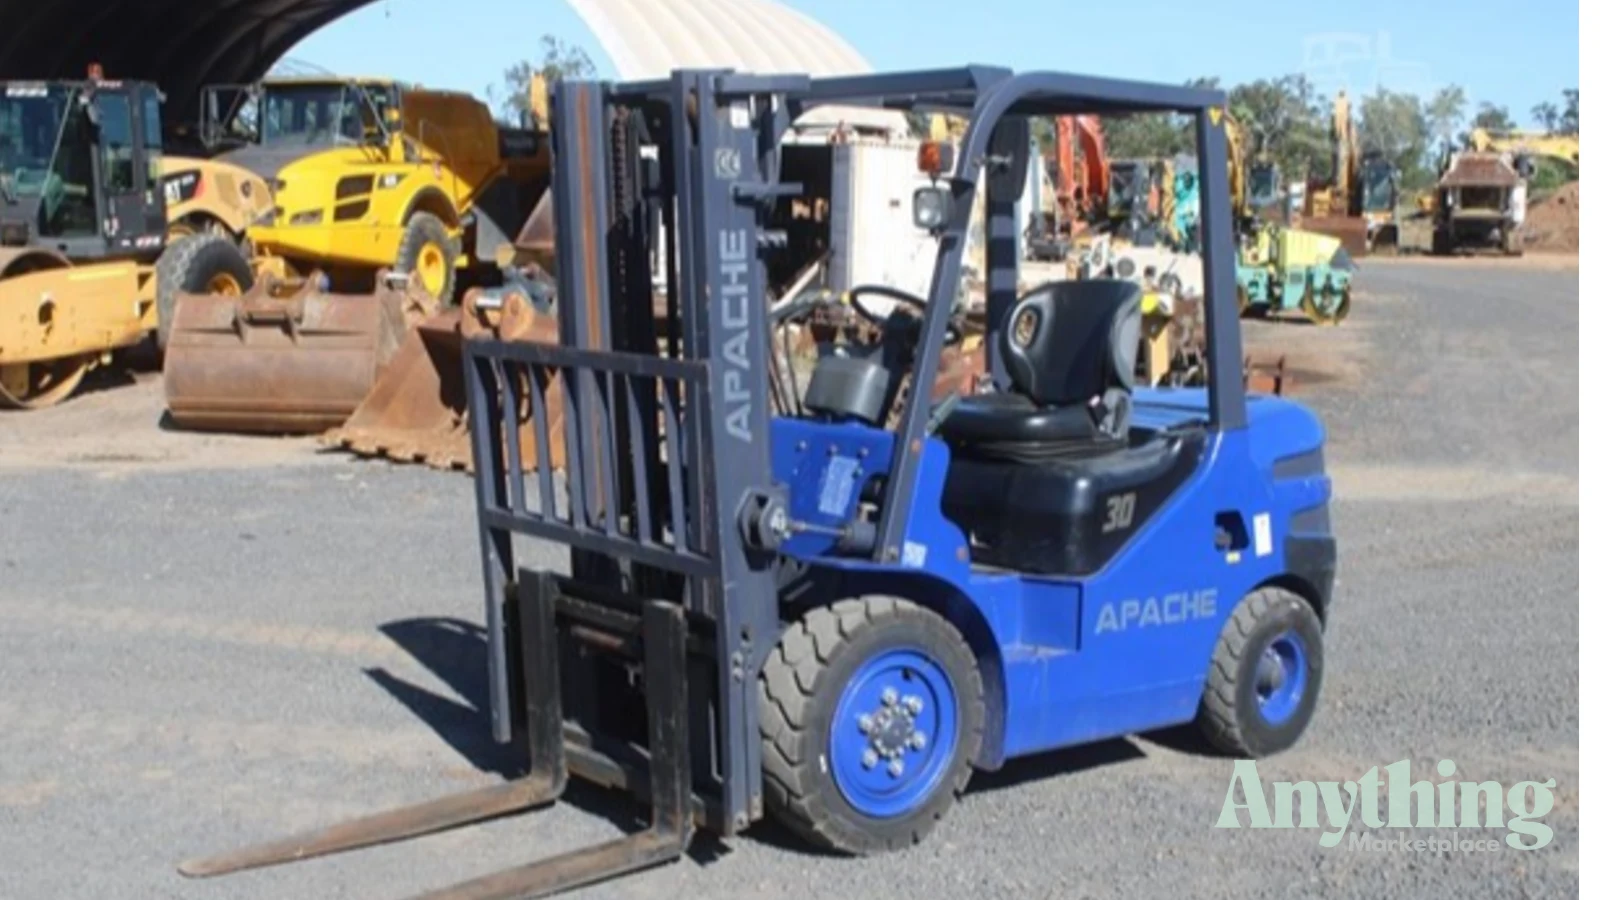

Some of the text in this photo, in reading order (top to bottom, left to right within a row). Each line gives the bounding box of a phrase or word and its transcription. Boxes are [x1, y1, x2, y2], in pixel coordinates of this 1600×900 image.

[719, 228, 752, 444] APACHE
[1102, 492, 1137, 533] 30
[1094, 588, 1218, 635] APACHE
